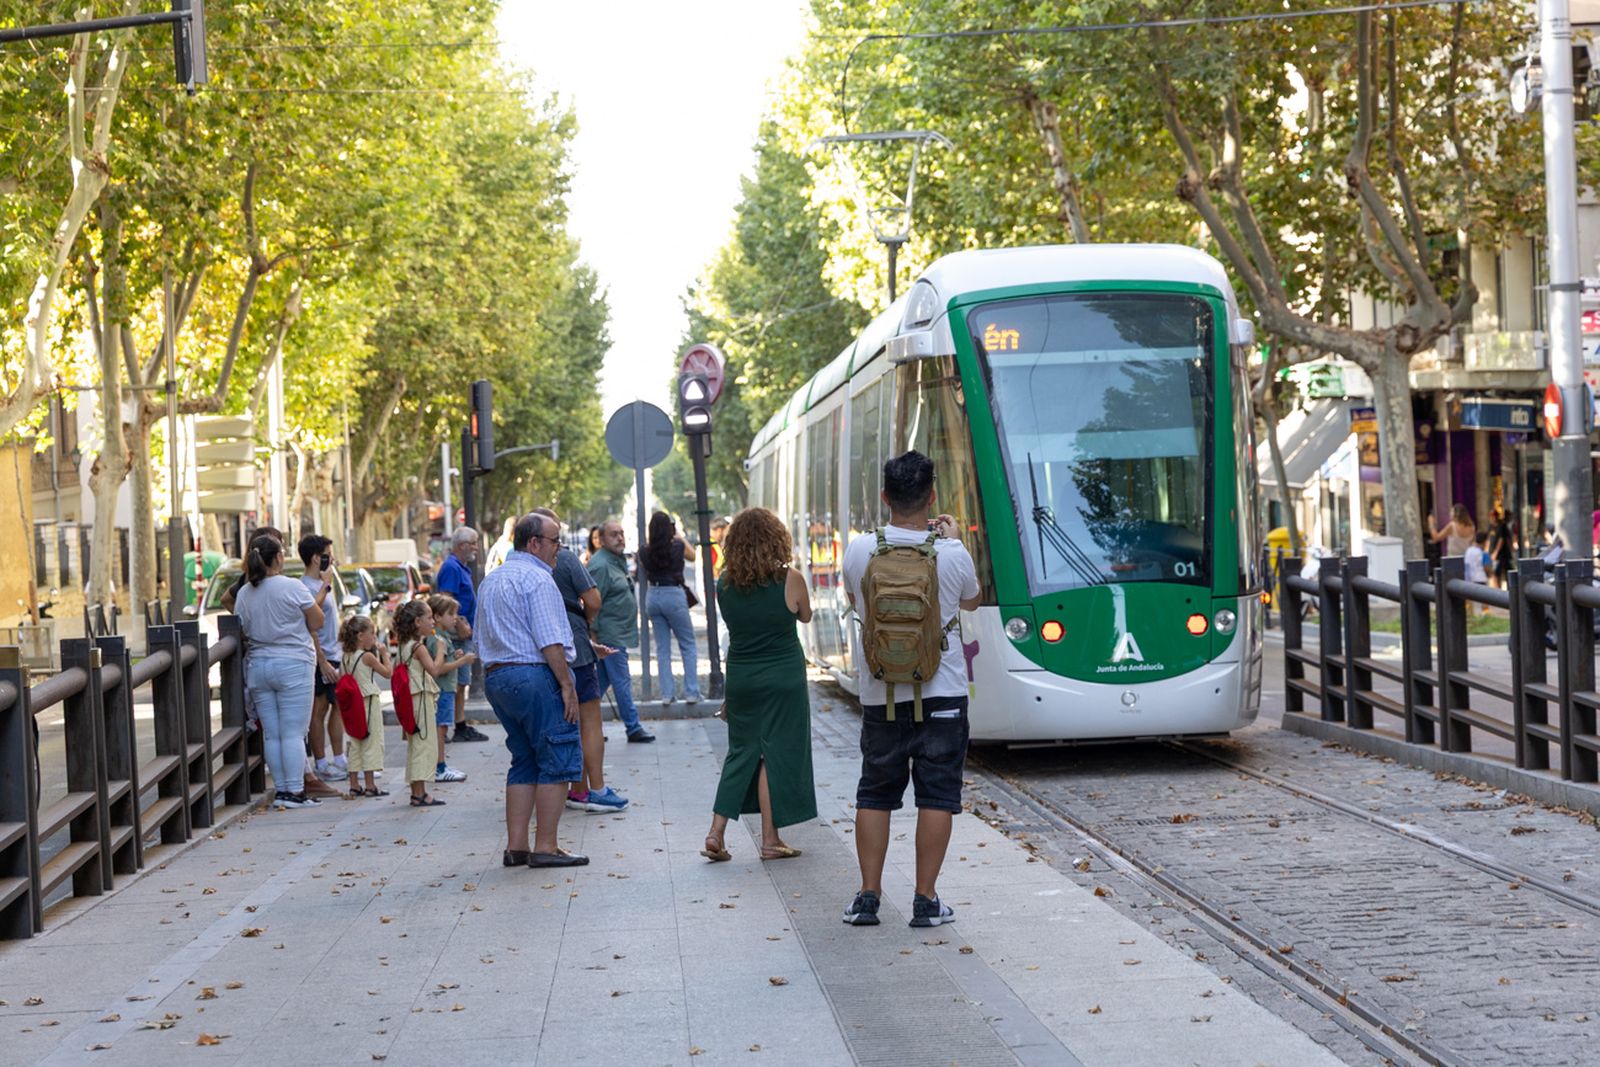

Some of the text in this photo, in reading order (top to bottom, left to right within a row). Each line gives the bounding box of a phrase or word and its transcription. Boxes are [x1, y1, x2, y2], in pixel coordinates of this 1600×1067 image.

[984, 322, 1019, 350] én
[1174, 561, 1195, 577] 01
[1096, 662, 1164, 673] Junta de Andalucía
